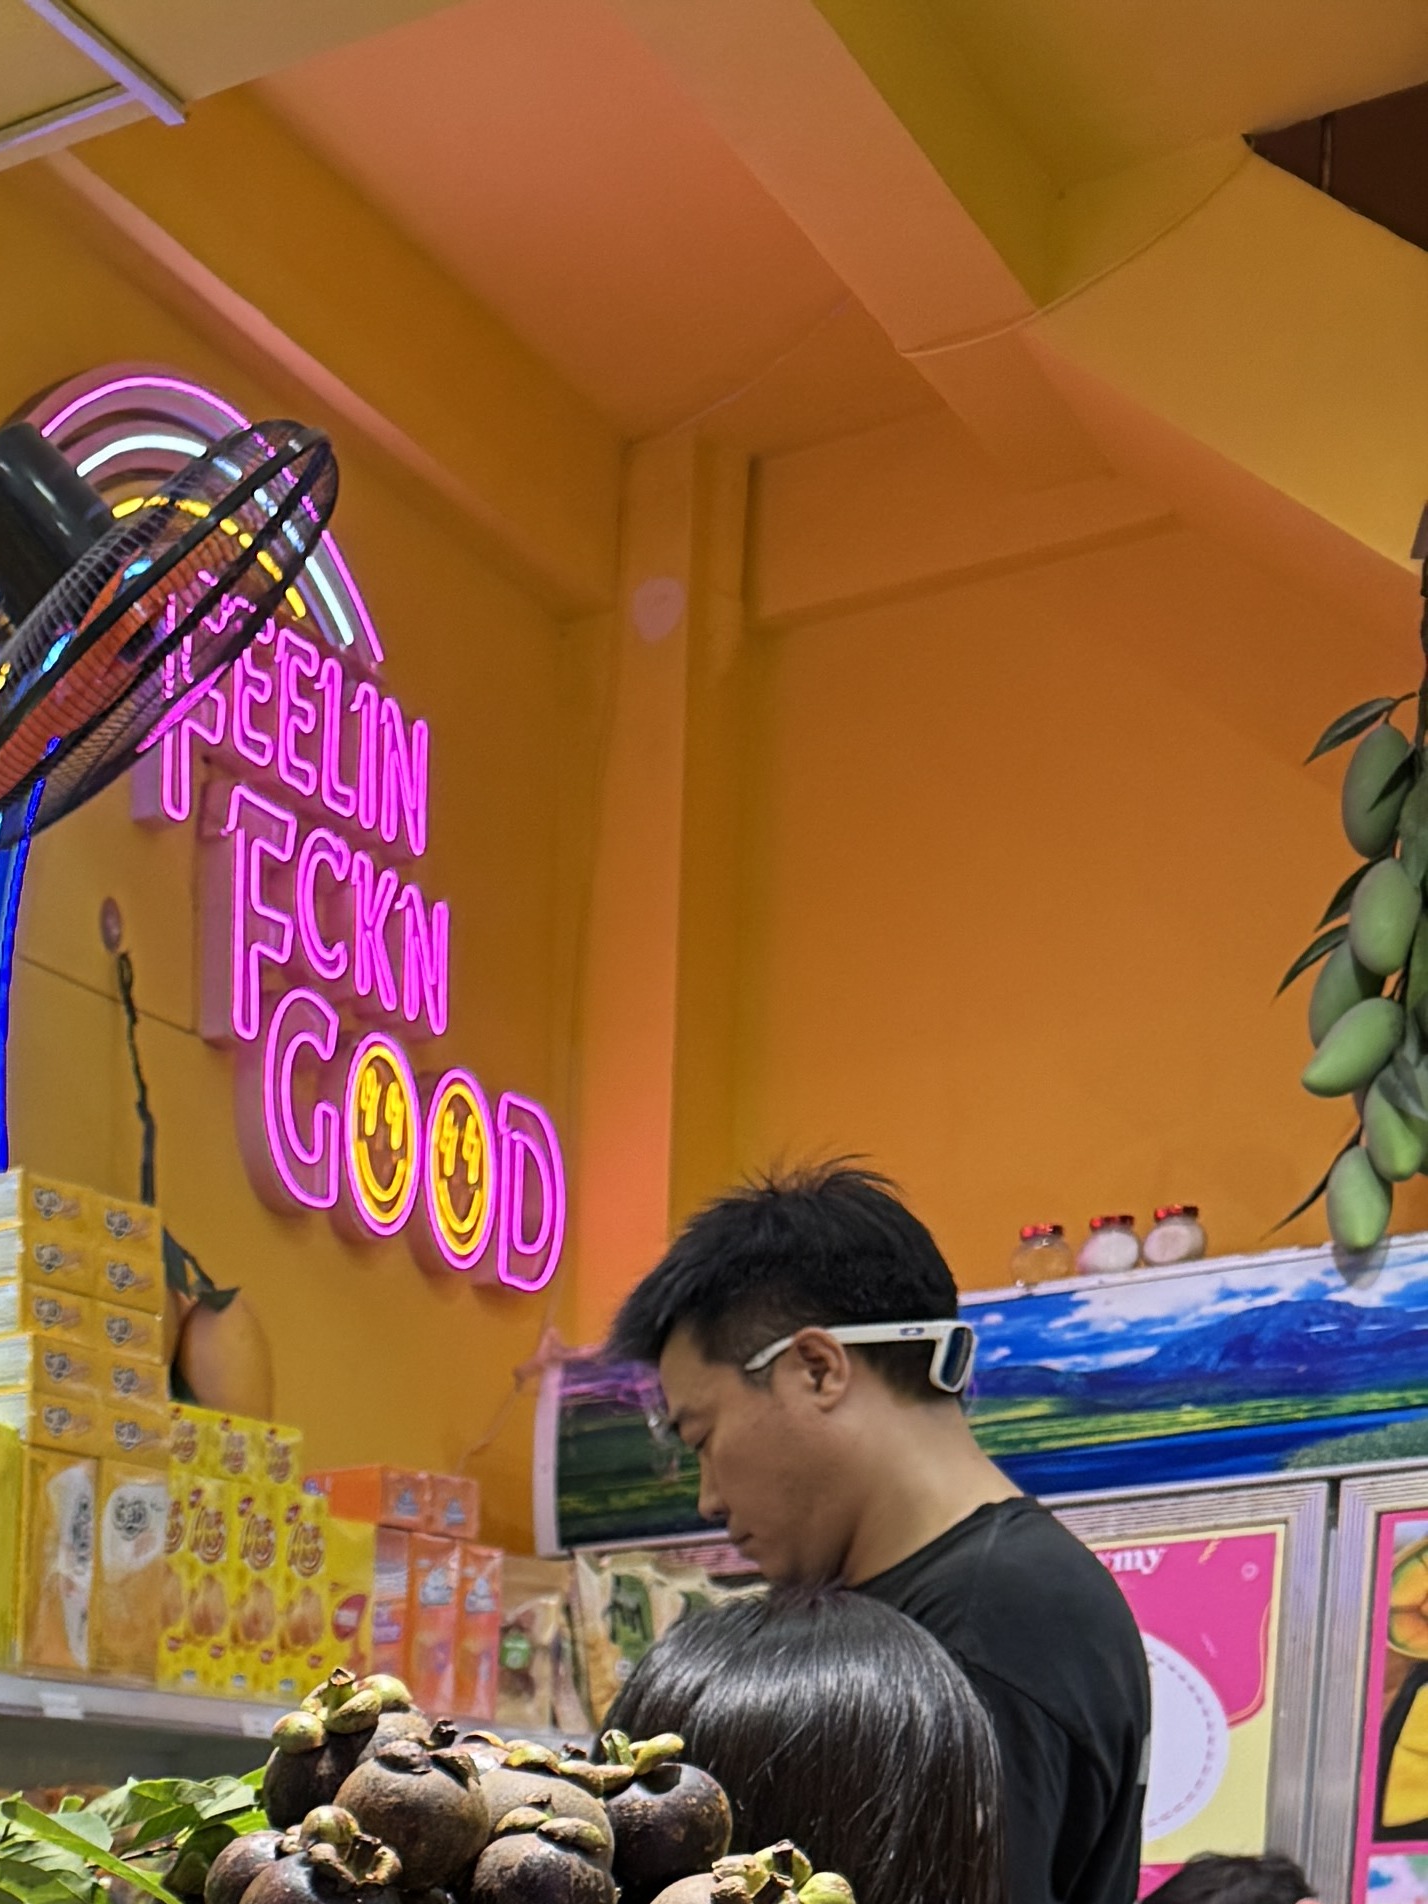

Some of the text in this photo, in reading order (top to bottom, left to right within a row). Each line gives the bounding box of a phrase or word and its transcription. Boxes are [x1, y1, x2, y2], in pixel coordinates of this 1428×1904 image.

[160, 572, 430, 858] FEELIN
[222, 783, 449, 1038] FCKN
[264, 987, 566, 1294] GOOD
[1096, 1547, 1168, 1576] my
